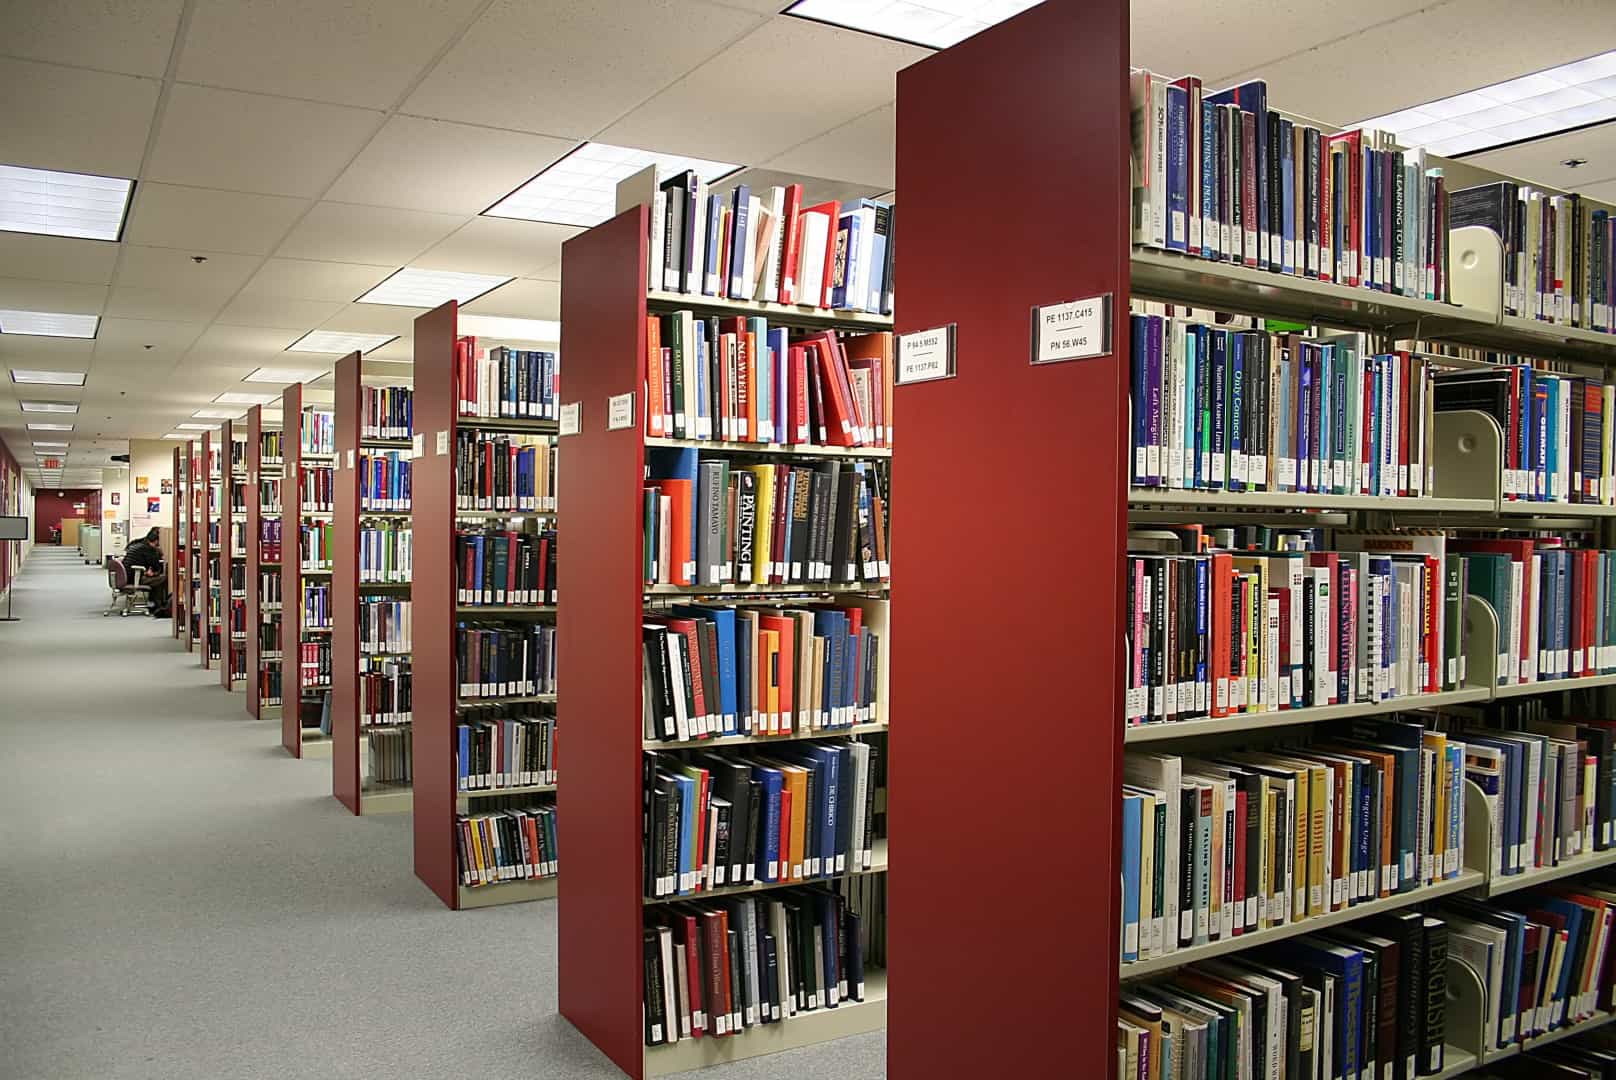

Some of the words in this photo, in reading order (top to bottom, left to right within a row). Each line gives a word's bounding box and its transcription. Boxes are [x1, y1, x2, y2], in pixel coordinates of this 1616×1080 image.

[1202, 185, 1211, 219] IMAGIN
[1396, 229, 1403, 243] TO
[1046, 314, 1056, 325] PE
[1057, 307, 1093, 322] 1137.C415
[1050, 341, 1061, 351] PN
[737, 362, 747, 404] WYETH
[906, 364, 914, 374] PE
[1232, 370, 1243, 396] Only
[1151, 386, 1160, 406] Left
[1233, 397, 1243, 441] Connect
[712, 471, 721, 502] RUFINO
[711, 503, 720, 535] TAMAYO
[741, 494, 755, 561] PAINTING
[1342, 569, 1351, 618] TELLING
[1341, 620, 1351, 676] WRITING
[1362, 794, 1370, 827] English
[1360, 829, 1370, 855] Usage
[1427, 944, 1450, 1043] ENGLISH
[1271, 1044, 1281, 1069] WORD
